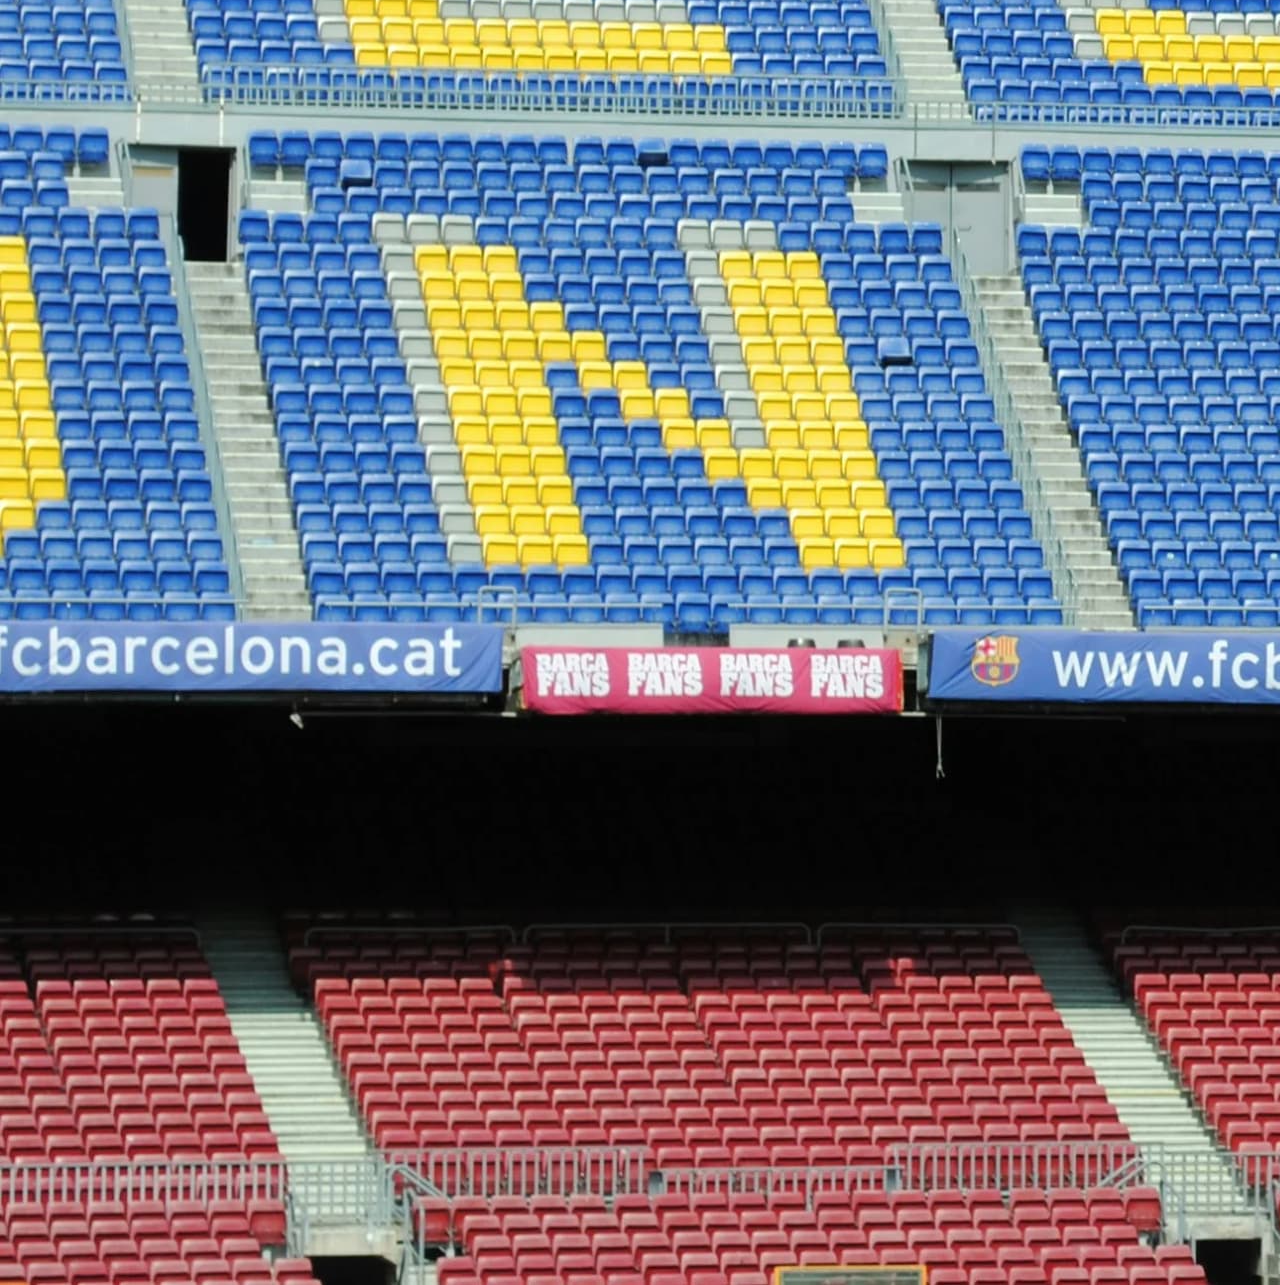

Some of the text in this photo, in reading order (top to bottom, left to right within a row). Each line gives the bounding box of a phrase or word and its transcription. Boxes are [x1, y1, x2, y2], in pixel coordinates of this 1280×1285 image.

[537, 671, 610, 697] FANS
[627, 671, 703, 697] FANS
[720, 671, 793, 697] FANS
[810, 672, 884, 698] FANS
